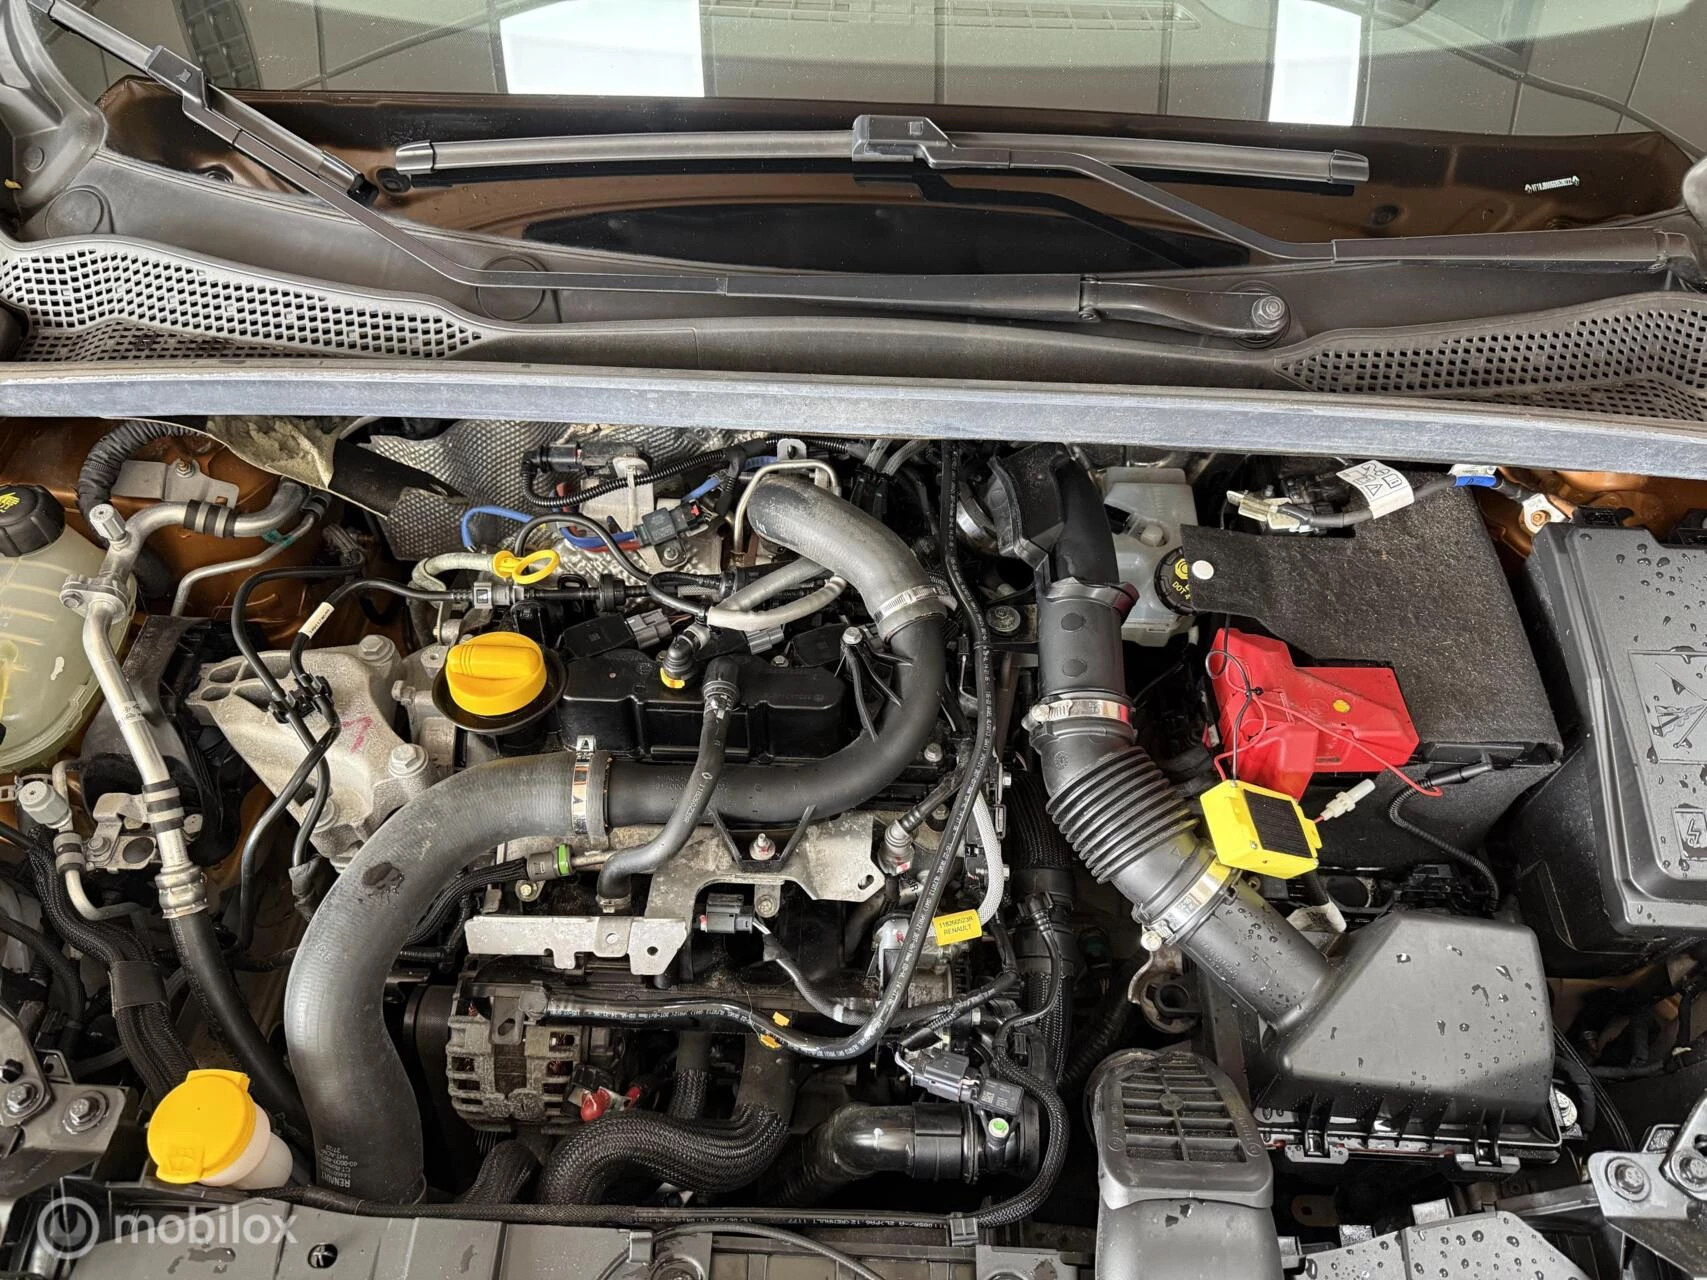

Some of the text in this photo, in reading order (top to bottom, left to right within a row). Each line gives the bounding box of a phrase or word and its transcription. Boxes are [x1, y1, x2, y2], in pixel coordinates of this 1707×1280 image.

[1172, 581, 1186, 594] DOT
[943, 924, 972, 935] RENAULT
[321, 1171, 351, 1188] RENAULT
